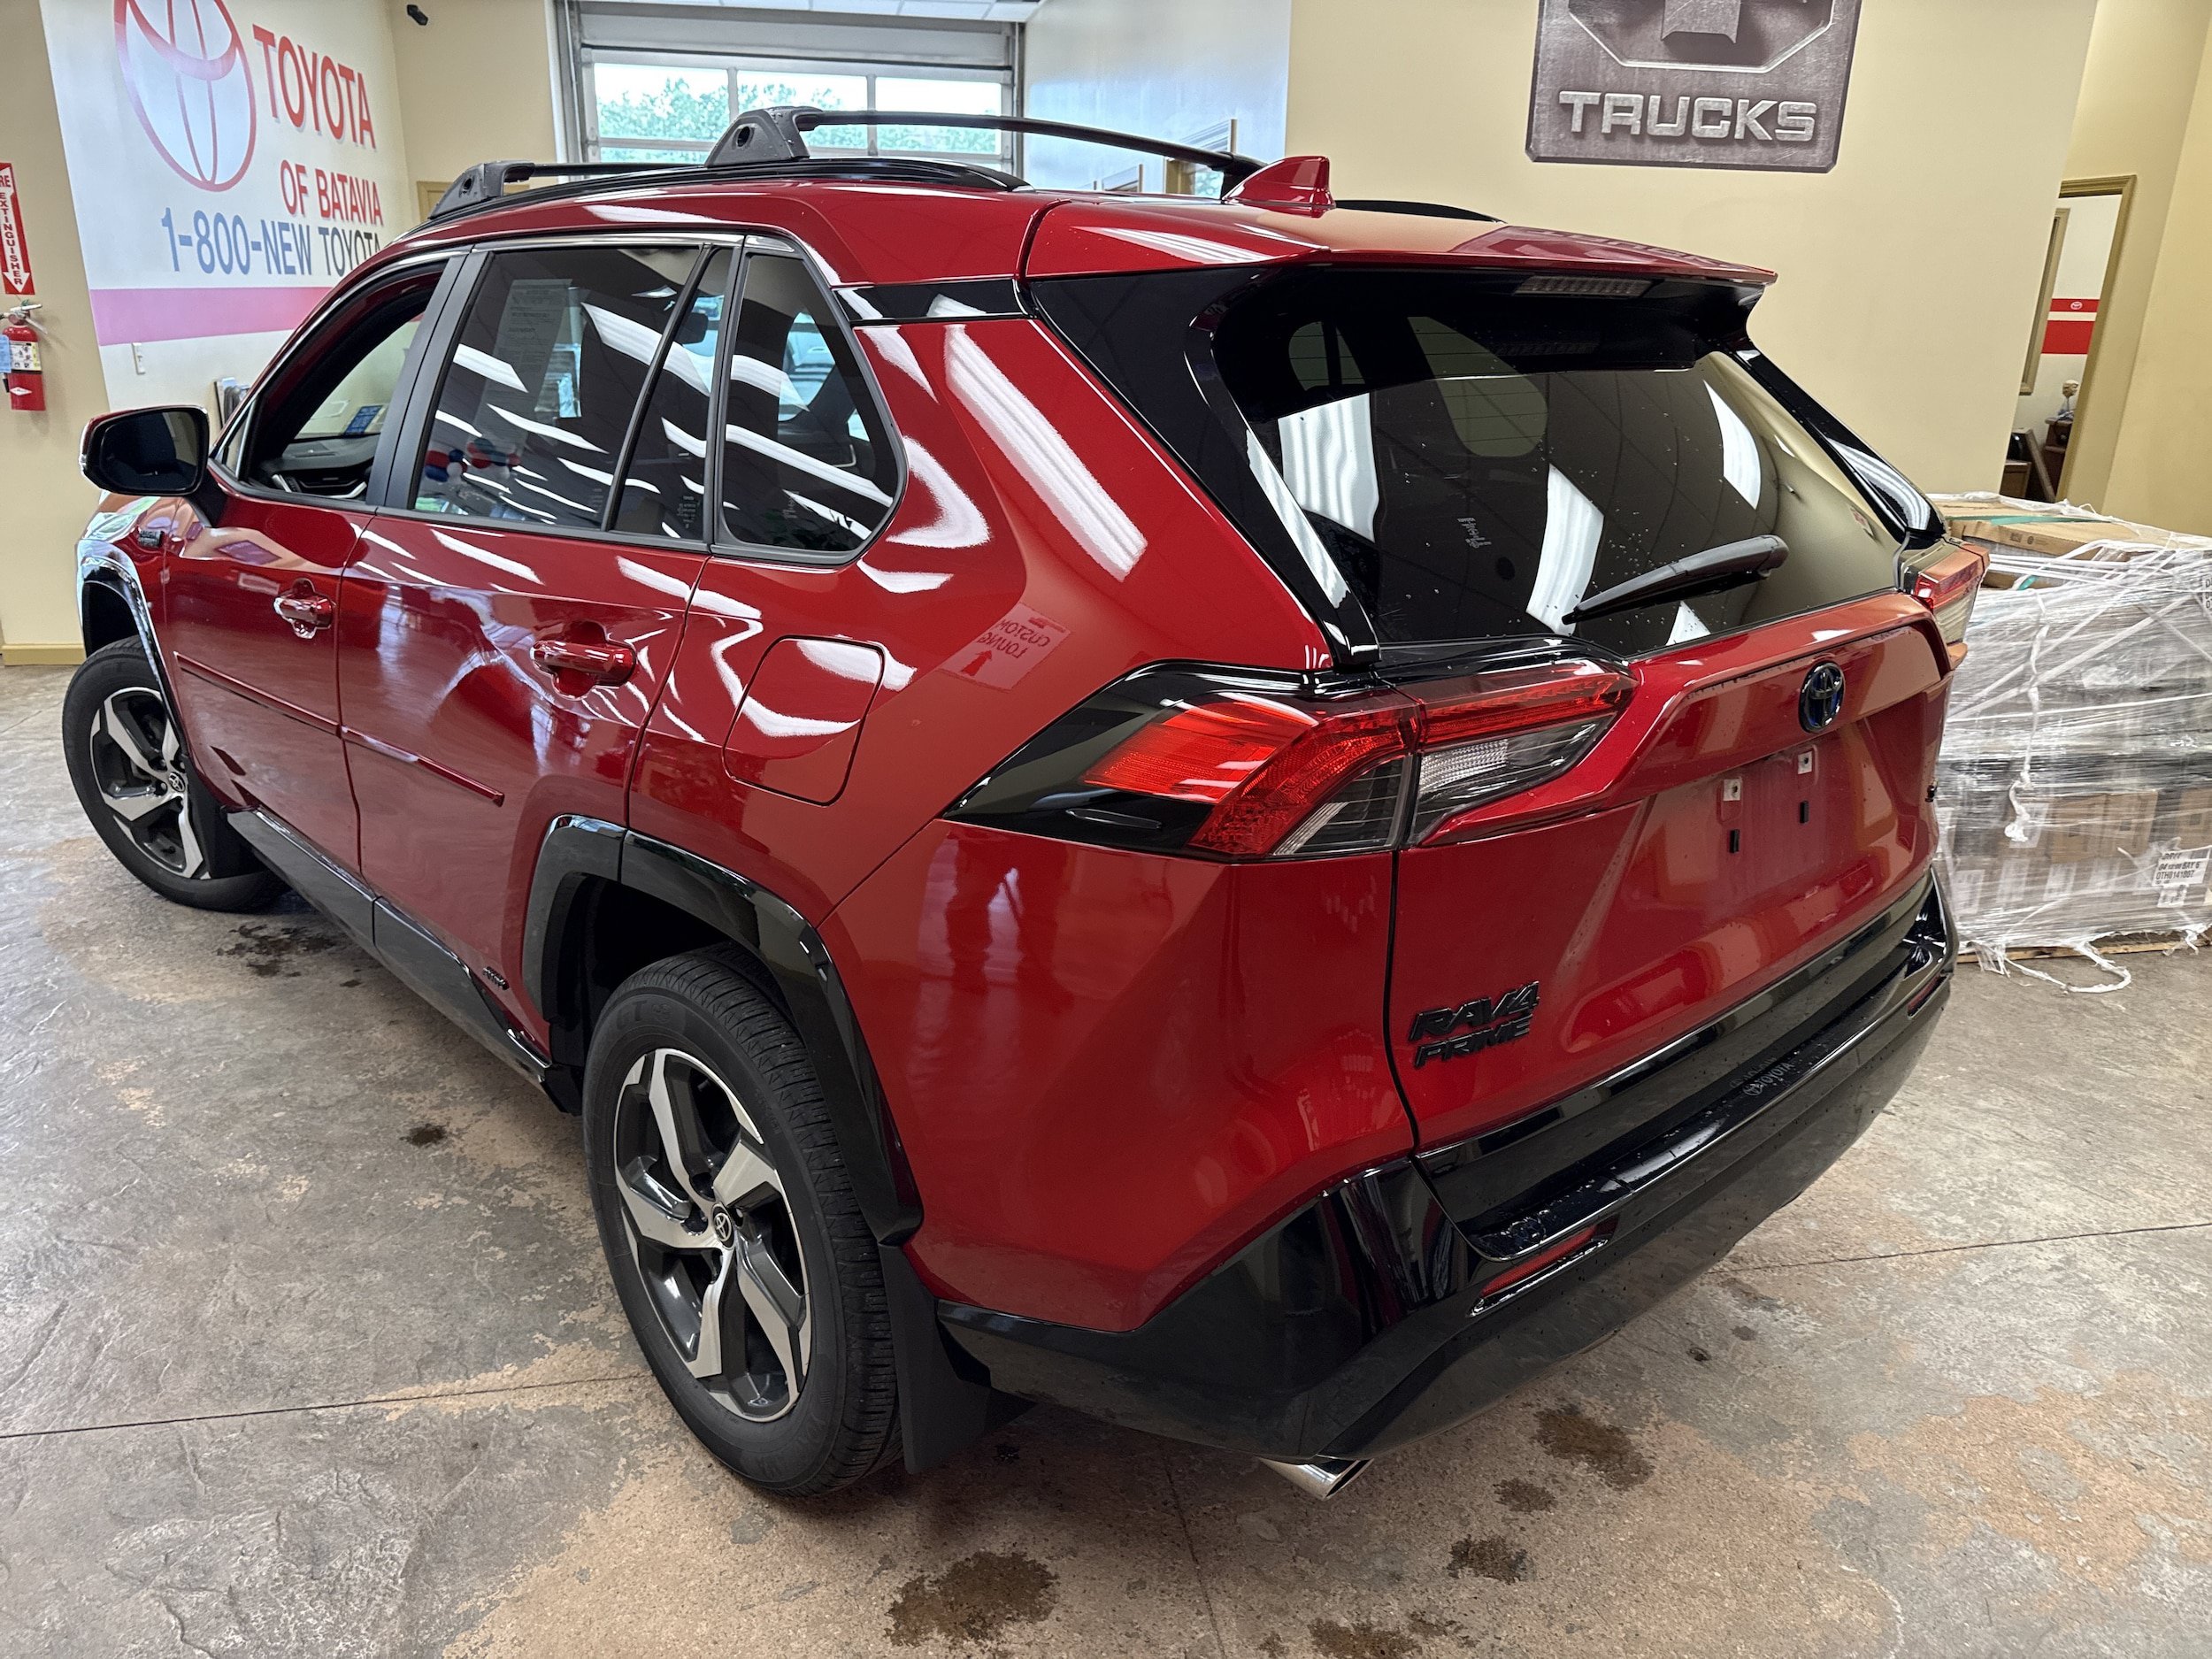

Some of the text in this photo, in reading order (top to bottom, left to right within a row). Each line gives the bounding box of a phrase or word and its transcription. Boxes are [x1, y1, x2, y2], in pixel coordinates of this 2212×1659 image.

[252, 23, 376, 150] TOYOTA
[1558, 90, 1817, 142] TRUCKS
[280, 159, 384, 226] OF BATAVIA
[0, 192, 23, 285] EXTINGUISHER
[161, 207, 312, 275] 1-800-NEW
[1408, 980, 1540, 1041] RAV4
[1414, 1014, 1533, 1068] PRIME
[1755, 1062, 1796, 1087] TOYOTA
